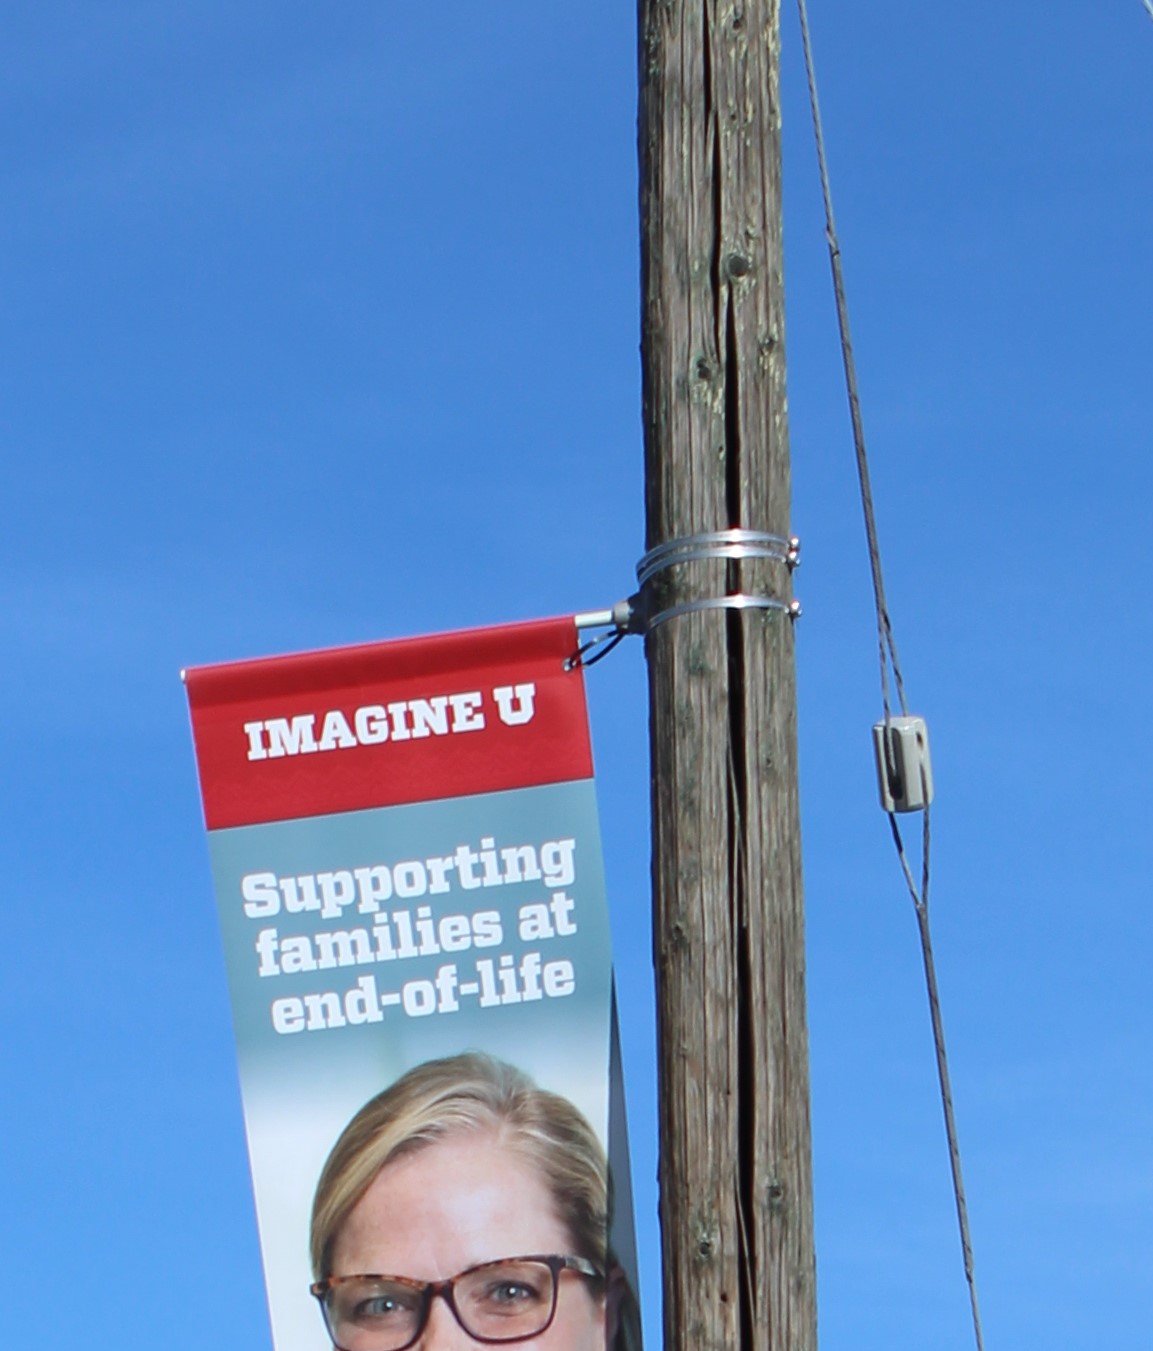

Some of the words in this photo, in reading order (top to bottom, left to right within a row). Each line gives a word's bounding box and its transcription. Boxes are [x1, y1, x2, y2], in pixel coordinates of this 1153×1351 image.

[244, 691, 485, 761] IMAGINE
[494, 683, 536, 726] U
[241, 836, 576, 918] Supporting
[255, 907, 503, 977] families
[518, 892, 577, 942] at
[271, 953, 576, 1035] end-of-life
